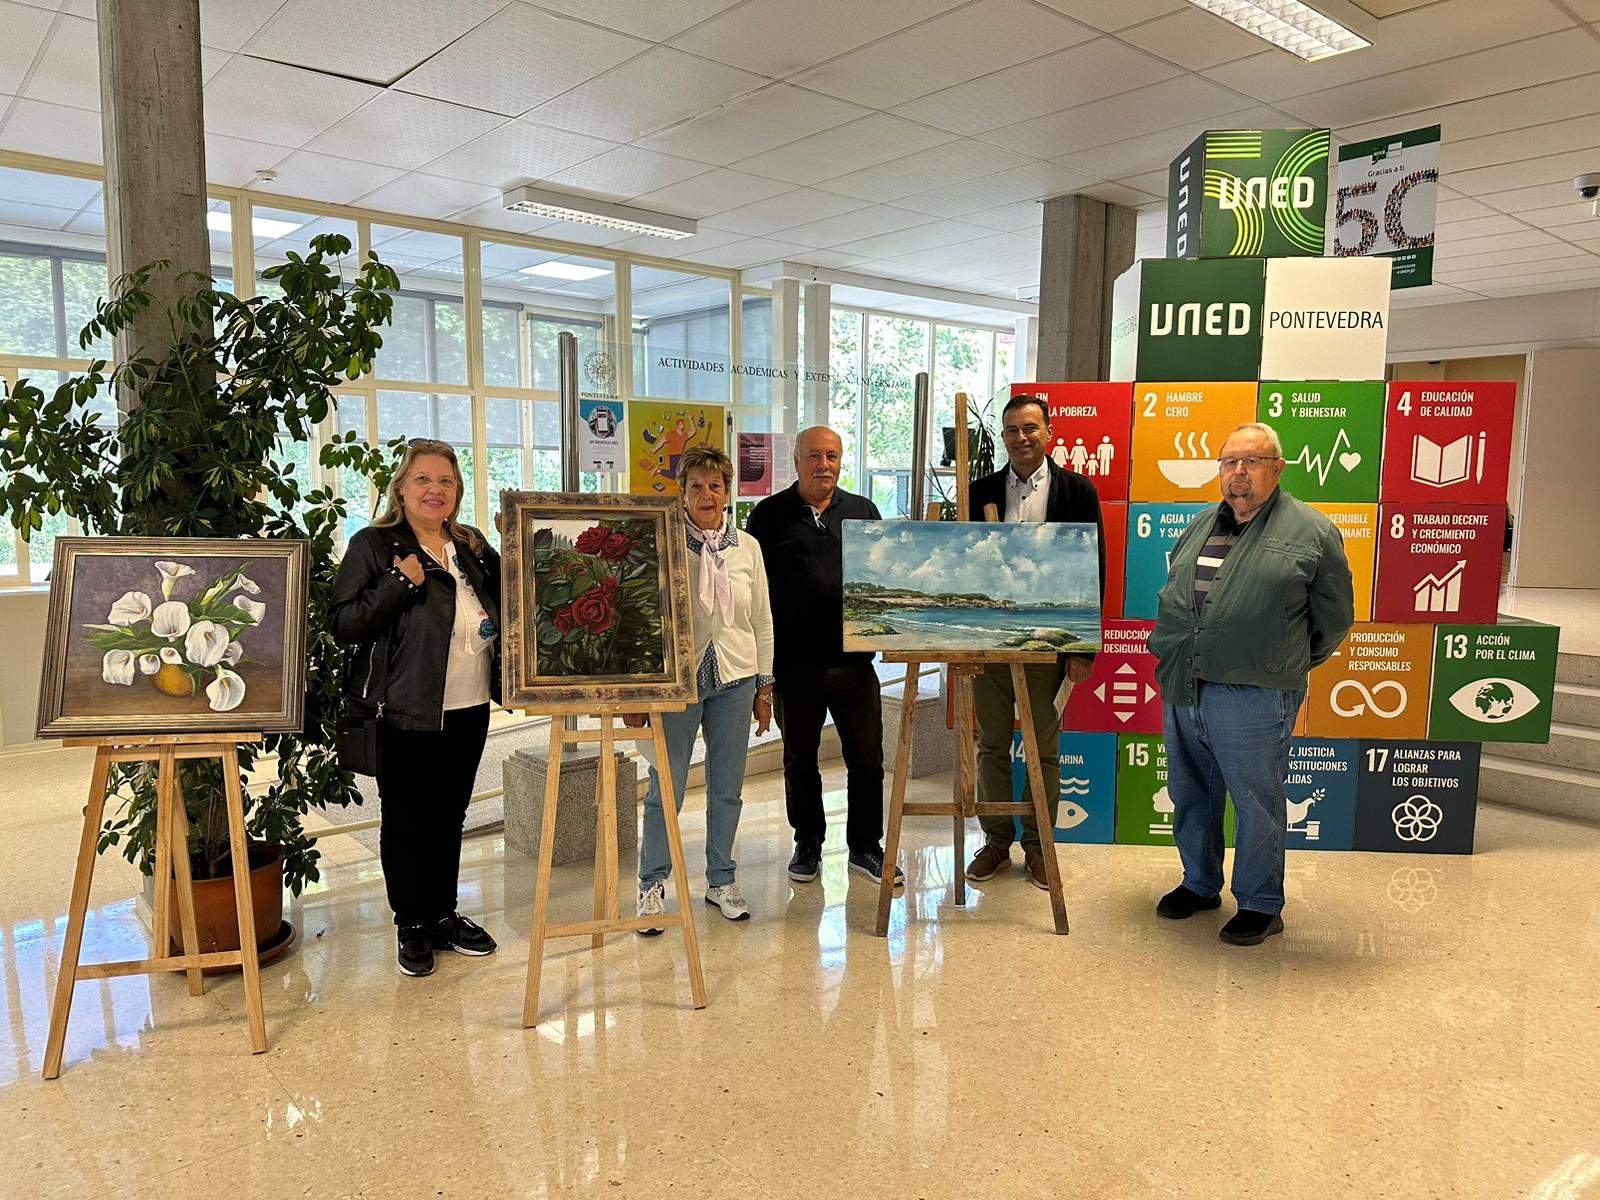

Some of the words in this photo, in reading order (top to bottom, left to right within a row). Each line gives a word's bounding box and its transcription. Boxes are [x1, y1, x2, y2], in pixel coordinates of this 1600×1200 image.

[1367, 167, 1393, 177] Gracias
[1219, 176, 1315, 209] UNED
[1176, 156, 1191, 258] UNED
[1150, 303, 1251, 336] UNED
[1269, 311, 1384, 329] PONTEVEDRA
[658, 357, 725, 373] ACTIVIDADES
[730, 364, 788, 379] ACADÉMICAS
[1166, 392, 1204, 402] HAMBRE
[1291, 392, 1321, 403] SALUD
[1421, 389, 1474, 402] EDUCACIÓN
[1143, 392, 1158, 417] 2
[1268, 392, 1283, 418] 3
[1396, 392, 1412, 416] 4
[1059, 406, 1098, 417] POBREZA
[1165, 406, 1189, 417] CERO
[1291, 407, 1298, 417] Y
[1300, 407, 1347, 418] BIENESTAR
[1420, 406, 1432, 416] DE
[1434, 406, 1473, 417] CALIDAD
[1160, 513, 1184, 524] AGUA
[1325, 513, 1369, 524] SEQUIBLE
[1412, 514, 1450, 526] TRABAJO
[1452, 514, 1488, 526] DECENTE
[1137, 513, 1152, 538] 6
[1390, 514, 1405, 539] 8
[1160, 528, 1166, 538] Y
[1412, 529, 1418, 539] Y
[1419, 529, 1476, 540] CRECIMIENTO
[1410, 541, 1462, 554] ECONÓMICO
[1350, 631, 1404, 644] PRODUCCIÓN
[1476, 633, 1510, 646] ACCIÓN
[1349, 647, 1356, 656] Y
[1357, 647, 1399, 658] CONSUMO
[1443, 634, 1468, 660] 13
[1476, 650, 1494, 660] POR
[1496, 650, 1506, 660] EL
[1508, 650, 1536, 660] CLIMA
[1348, 660, 1411, 672] RESPONSABLES
[1126, 743, 1149, 766] 15
[1297, 747, 1336, 758] JUSTICIA
[1394, 749, 1436, 760] ALIANZAS
[1438, 750, 1462, 760] PARA
[1059, 754, 1084, 765] ARINA
[1288, 760, 1348, 771] NSTITUCIONES
[1366, 748, 1389, 772] 17
[1393, 762, 1428, 774] LOGRAR
[1284, 774, 1312, 784] LIDAS
[1392, 777, 1408, 787] LOS
[1411, 777, 1459, 788] OBJETIVOS
